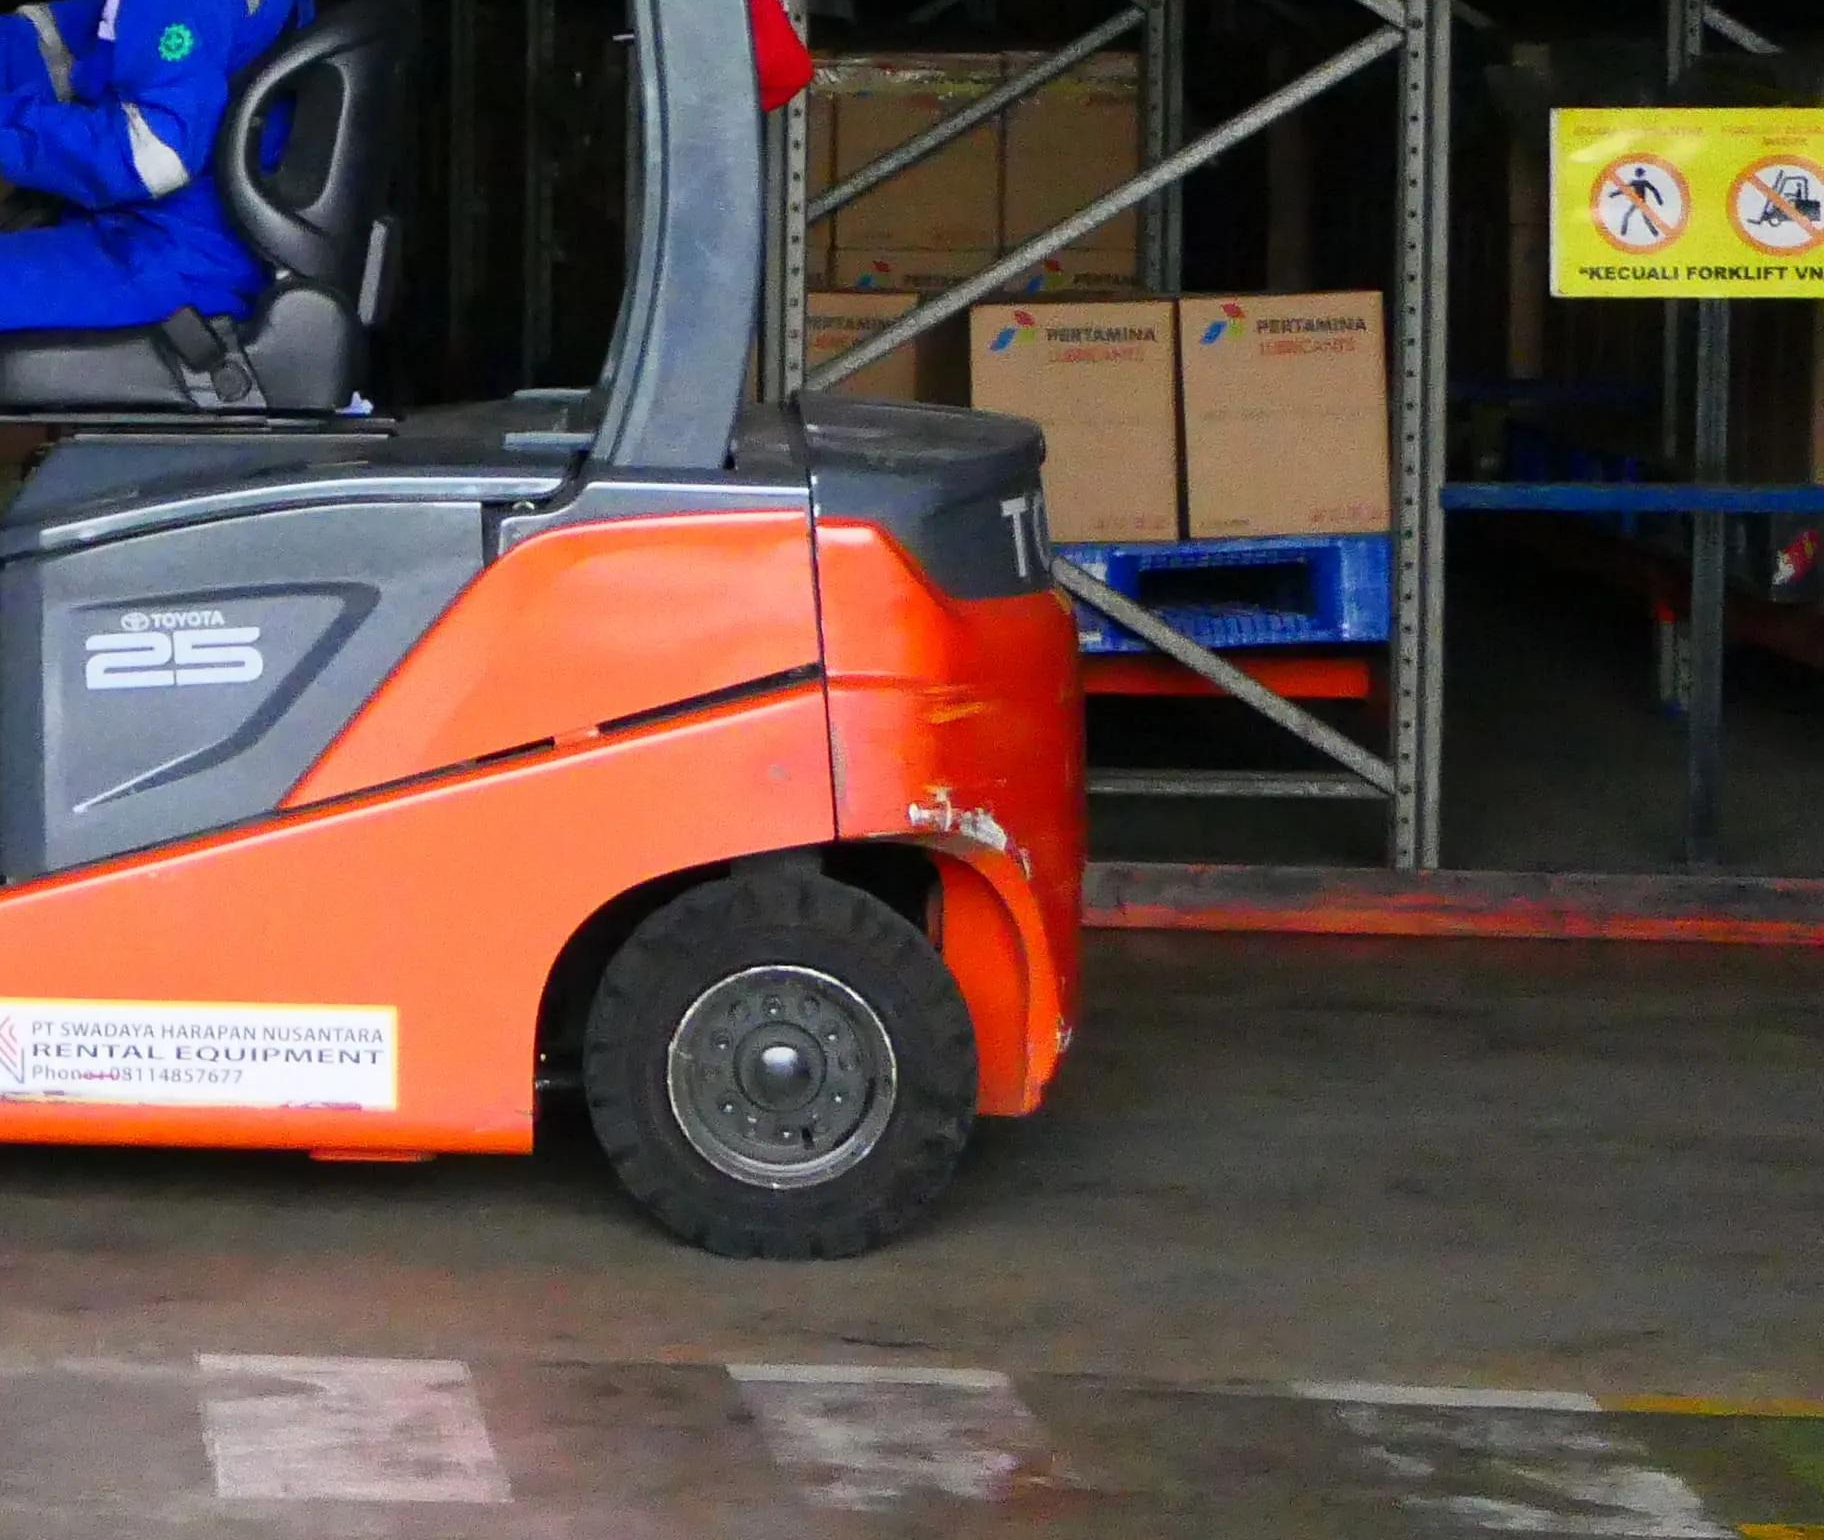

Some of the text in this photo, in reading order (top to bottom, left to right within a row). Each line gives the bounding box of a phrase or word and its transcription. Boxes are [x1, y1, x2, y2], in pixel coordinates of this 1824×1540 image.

[1687, 265, 1789, 282] FORKLIFT
[151, 611, 225, 628] TOYOTA
[85, 626, 263, 690] 25
[32, 1020, 383, 1044] PT SWADAYA HARAPAN NUSANTARA
[32, 1043, 384, 1064] RENTAL EQUIPMENT
